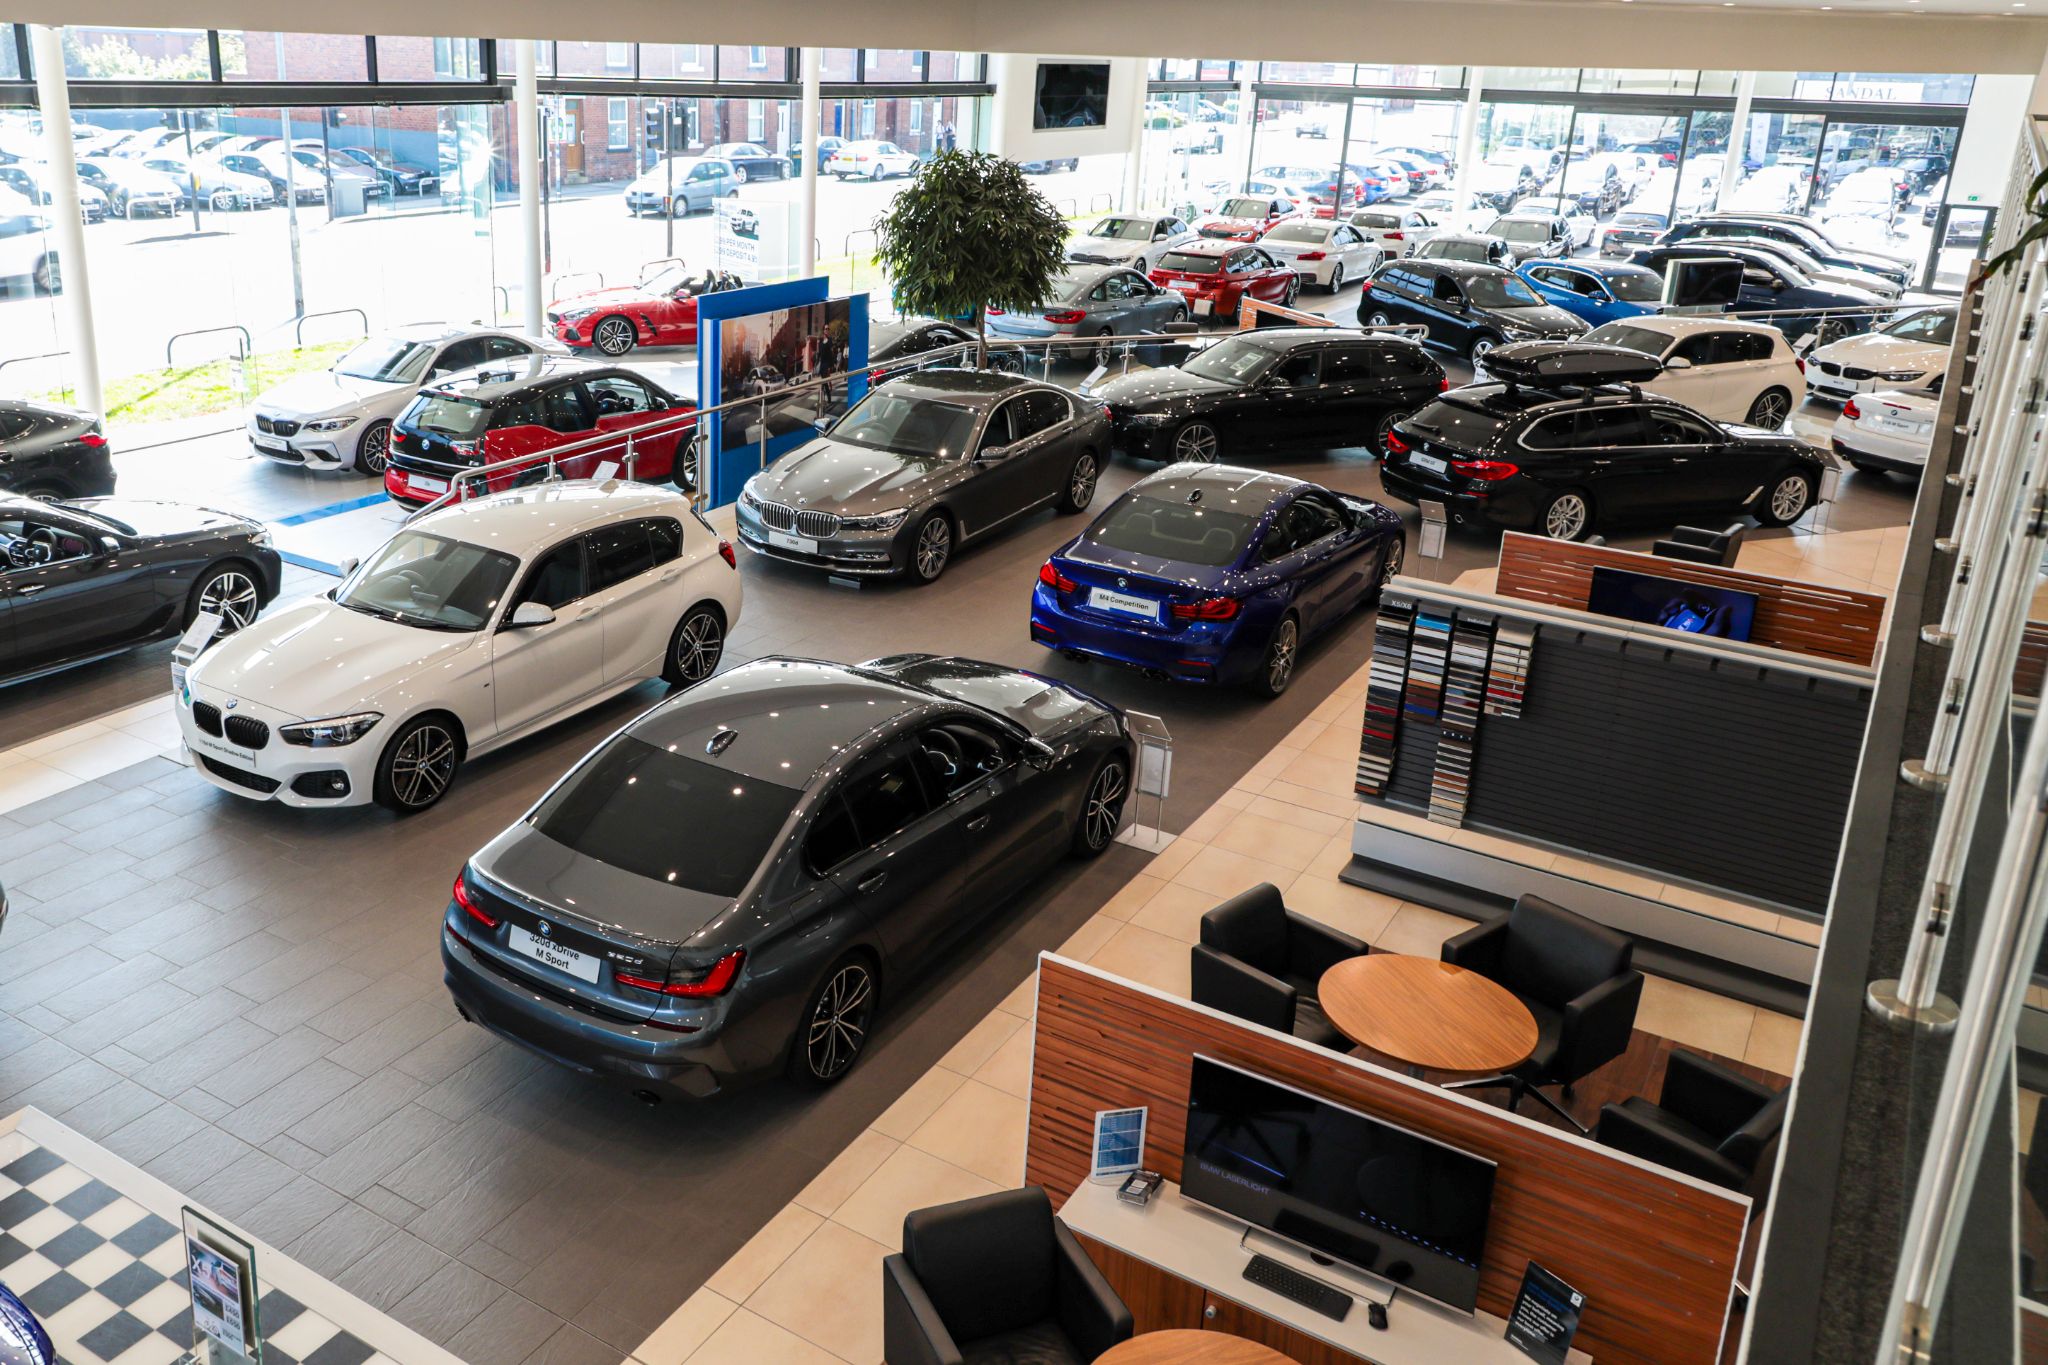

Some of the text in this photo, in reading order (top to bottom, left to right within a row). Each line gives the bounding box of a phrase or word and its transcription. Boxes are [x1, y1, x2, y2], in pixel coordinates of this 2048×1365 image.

[1826, 87, 1897, 100] SANDAL
[1099, 593, 1149, 610] M4 Competition
[1391, 600, 1412, 610] X5/X6
[530, 933, 580, 961] 320d xDrive
[536, 948, 570, 970] M Sport
[1200, 1162, 1270, 1195] BMW LASERLIGHT
